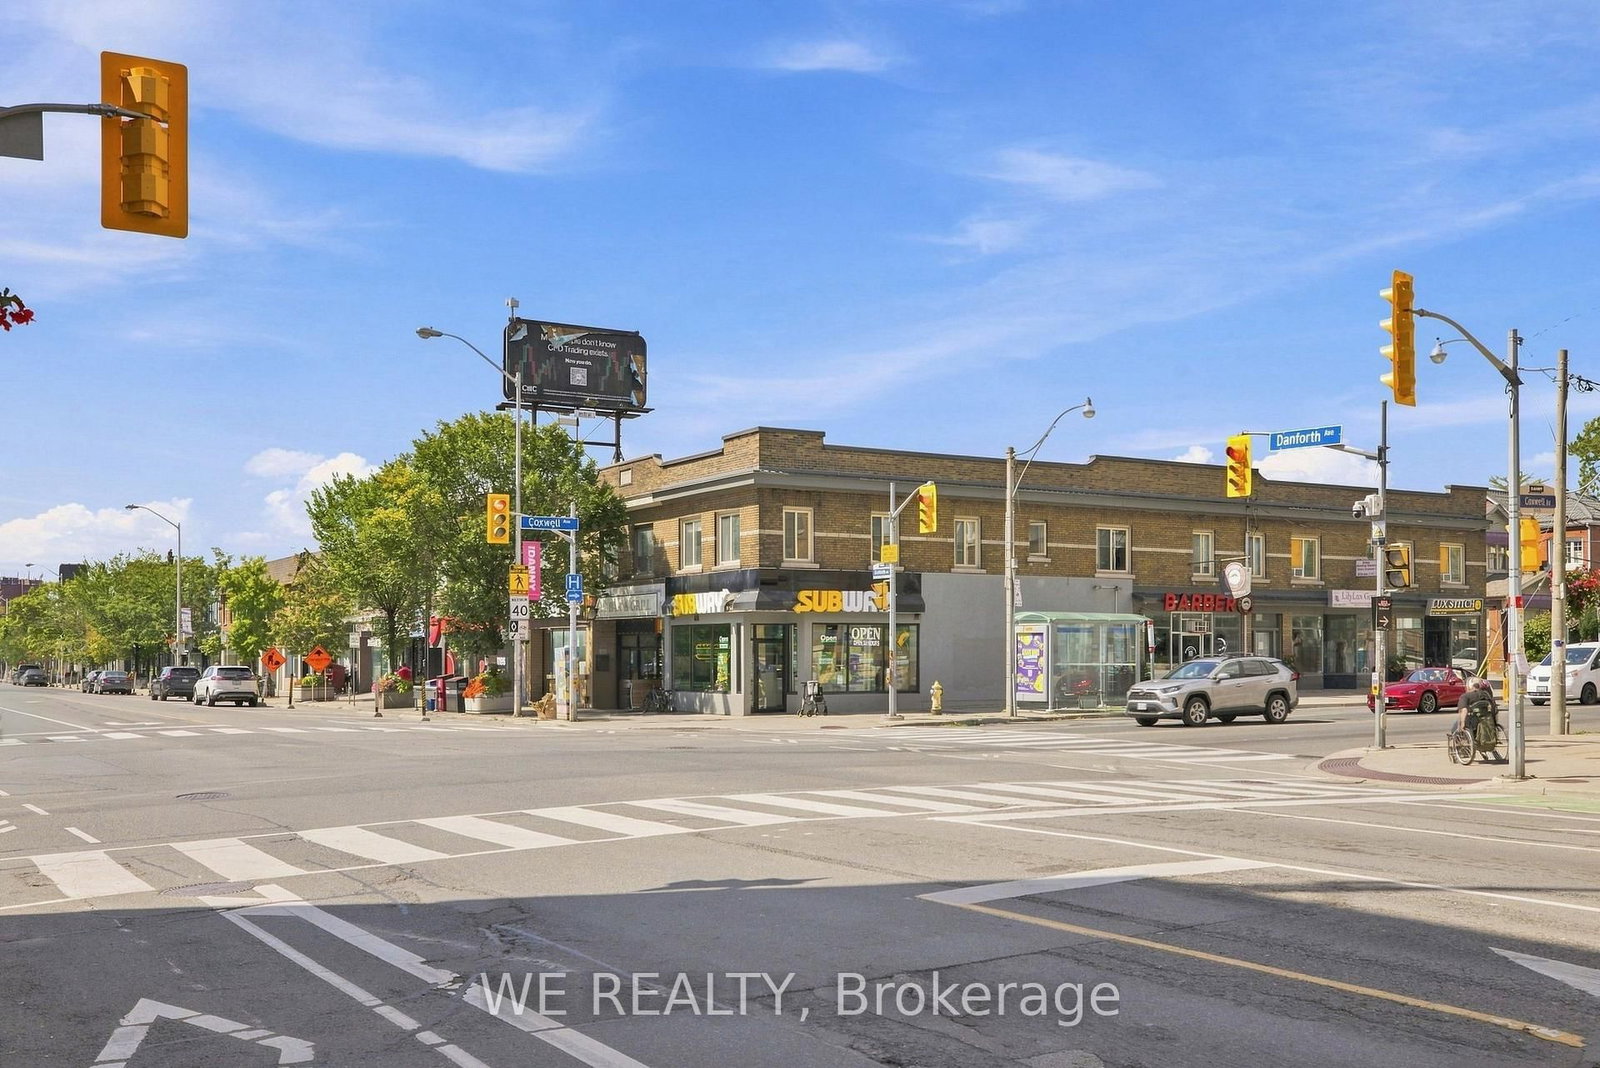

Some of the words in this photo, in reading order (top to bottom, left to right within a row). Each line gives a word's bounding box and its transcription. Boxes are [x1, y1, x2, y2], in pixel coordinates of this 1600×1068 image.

[564, 345, 589, 356] Trading
[599, 340, 617, 349] know
[1276, 431, 1321, 447] Danforth
[528, 517, 561, 528] Coxwell
[568, 575, 580, 589] H
[672, 588, 730, 616] SUBWAY
[793, 590, 896, 614] SUBWA
[1164, 591, 1237, 612] BARBER
[512, 605, 528, 616] 40
[820, 634, 837, 642] Open
[851, 627, 881, 640] OPEN
